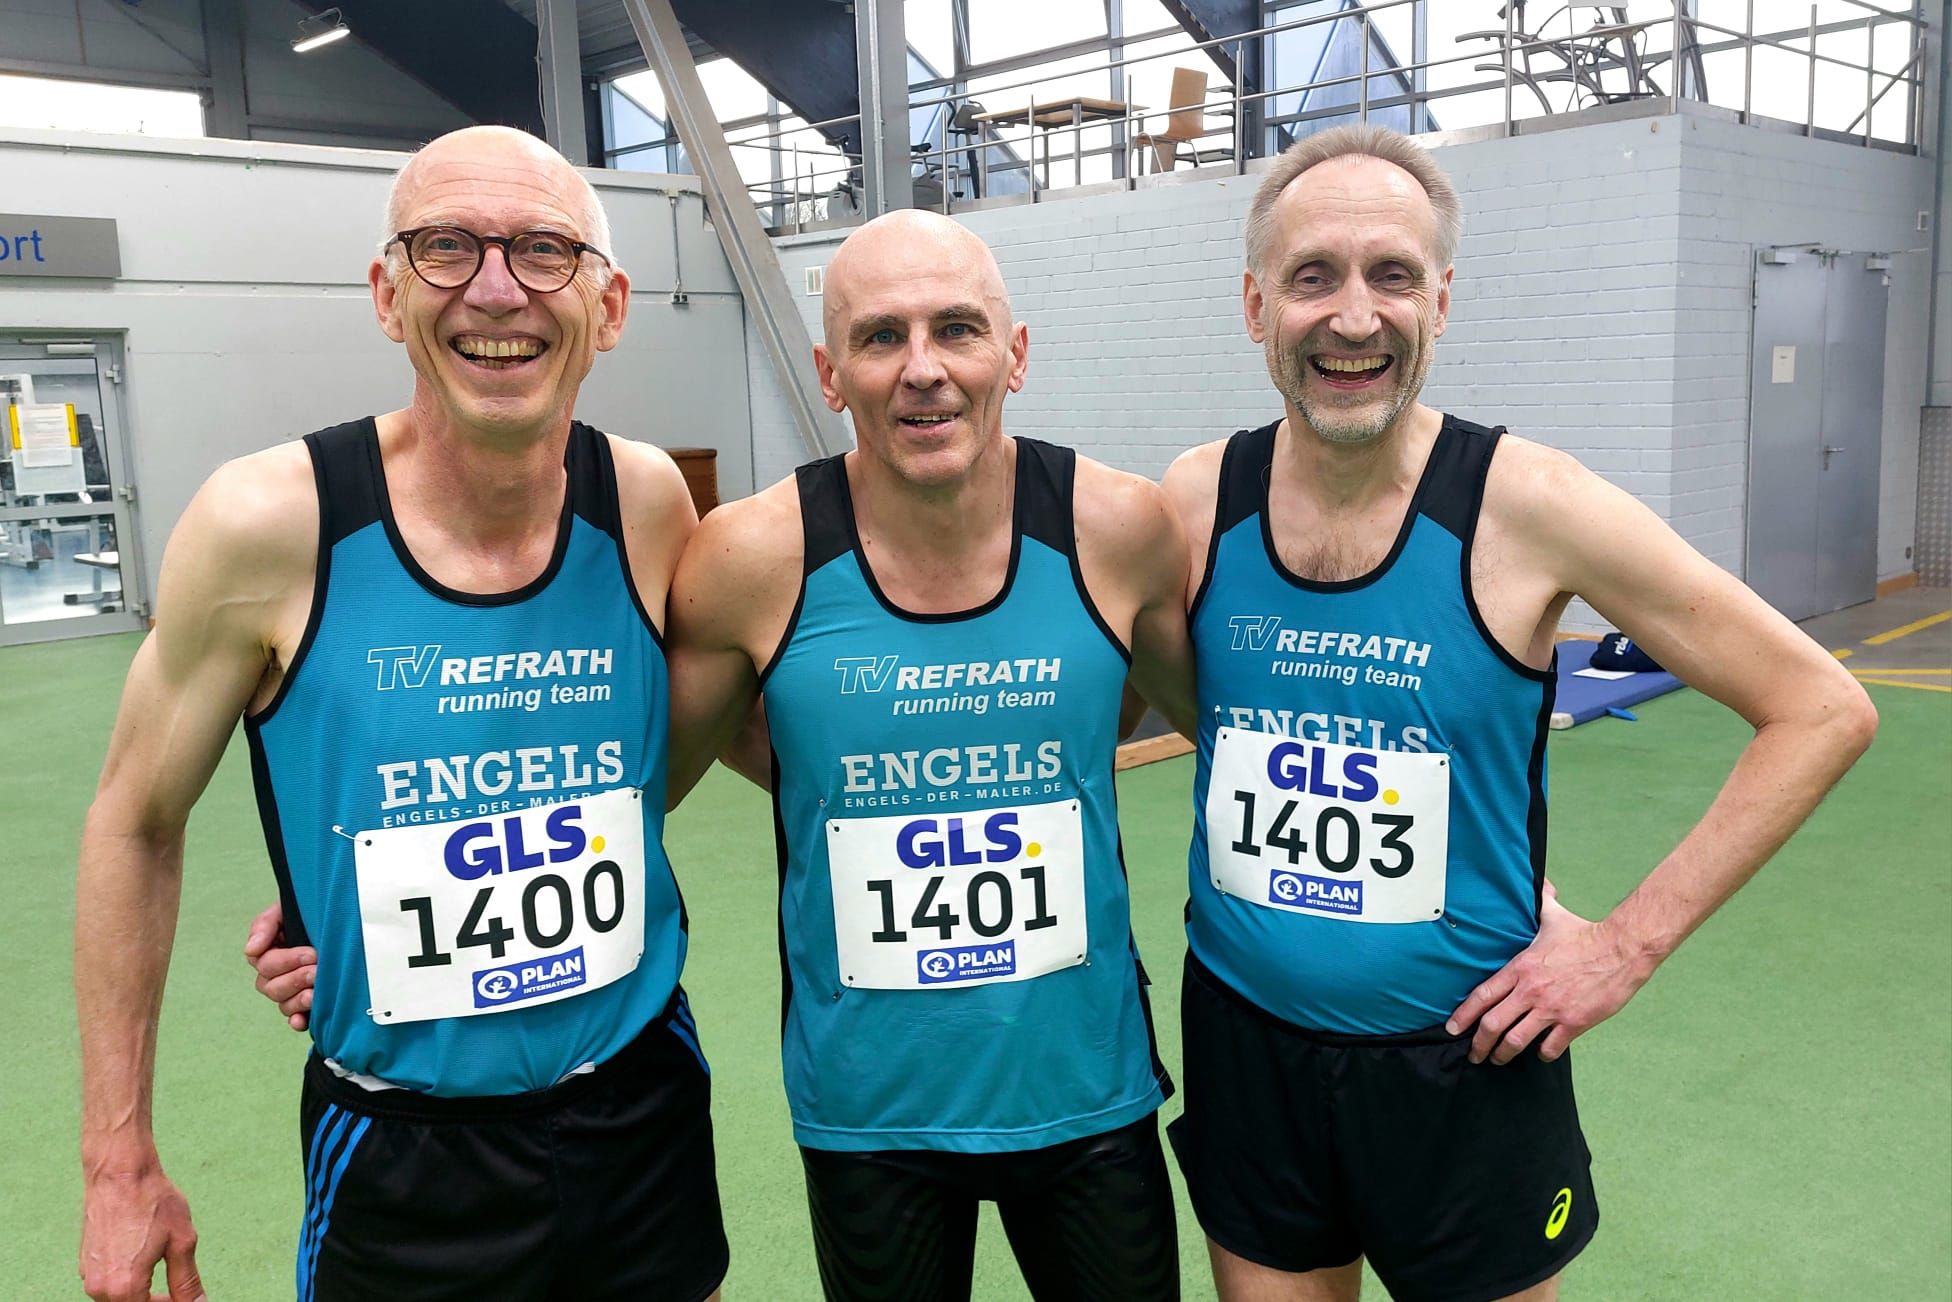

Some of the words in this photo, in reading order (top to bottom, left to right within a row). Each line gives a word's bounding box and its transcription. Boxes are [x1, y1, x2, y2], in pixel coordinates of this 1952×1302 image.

[1228, 615, 1282, 651] TV
[1276, 629, 1433, 667] REFRATH
[367, 644, 441, 691] TV
[440, 648, 614, 686] REFRATH
[834, 655, 899, 694] TV
[896, 658, 1061, 692] REFRATH
[1271, 659, 1357, 683] running
[1364, 665, 1422, 691] team
[438, 688, 541, 714] running
[550, 683, 611, 705] team
[892, 693, 989, 716] running
[996, 689, 1056, 708] team
[377, 740, 623, 811] ENGELS
[840, 740, 1062, 793] ENGELS
[1231, 789, 1414, 879] 1403
[866, 866, 1058, 943] 1401
[1305, 880, 1359, 903] PLAN
[1305, 898, 1359, 911] INTERNATIONAL
[400, 858, 625, 969] 1400
[521, 956, 582, 985] PLAN
[957, 947, 1012, 968] PLAN
[959, 965, 1012, 976] INTERNATIONAL
[523, 976, 583, 995] INTERNATIONAL
